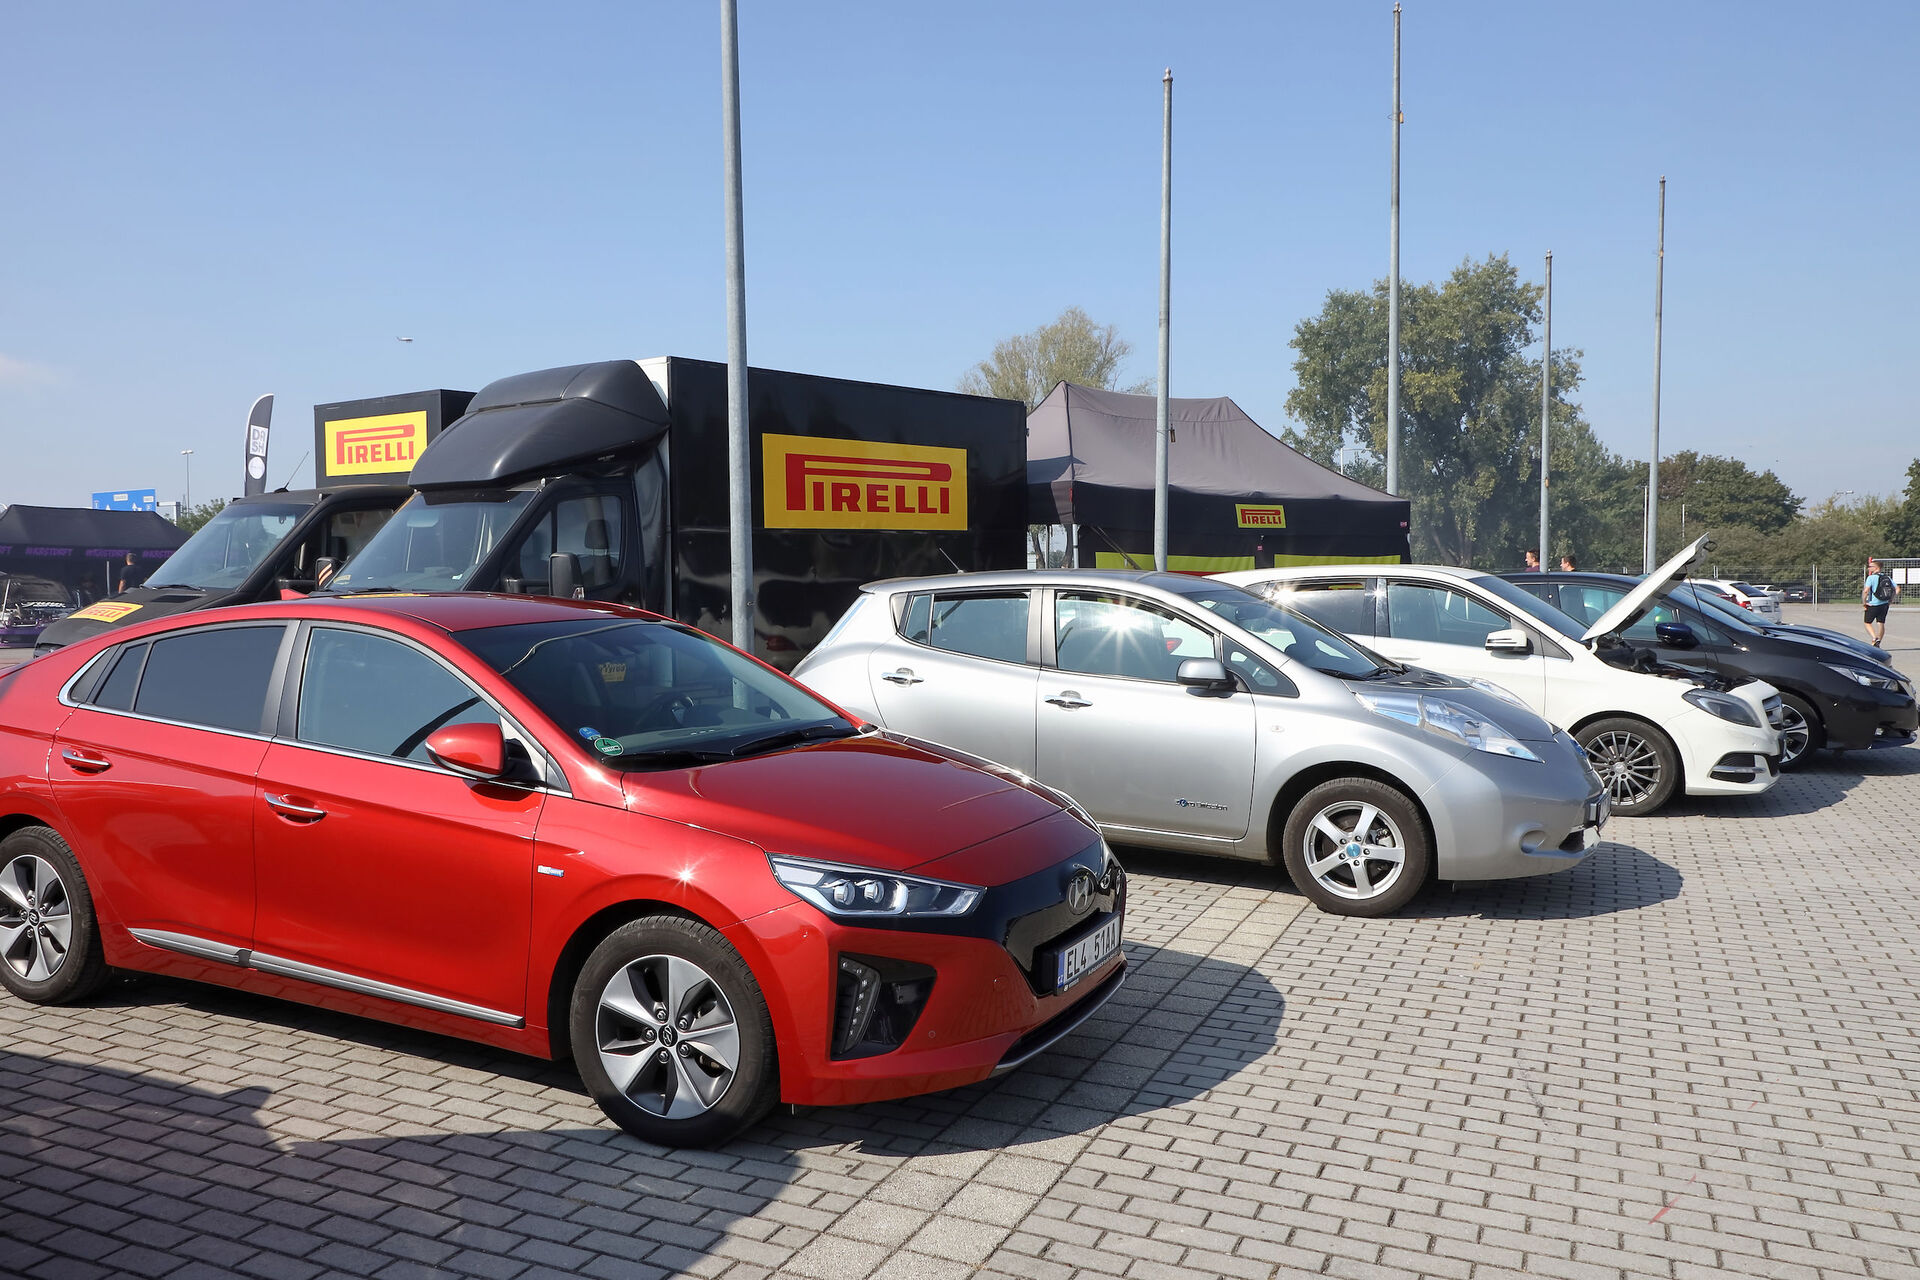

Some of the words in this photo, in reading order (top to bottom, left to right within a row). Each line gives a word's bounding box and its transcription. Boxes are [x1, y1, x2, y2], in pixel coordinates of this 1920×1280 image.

[336, 424, 415, 465] PIRELLI
[785, 453, 952, 514] PIRELLI
[1240, 509, 1282, 524] PIRELLI
[1066, 942, 1087, 980] EL4
[1094, 922, 1116, 960] 51AA
